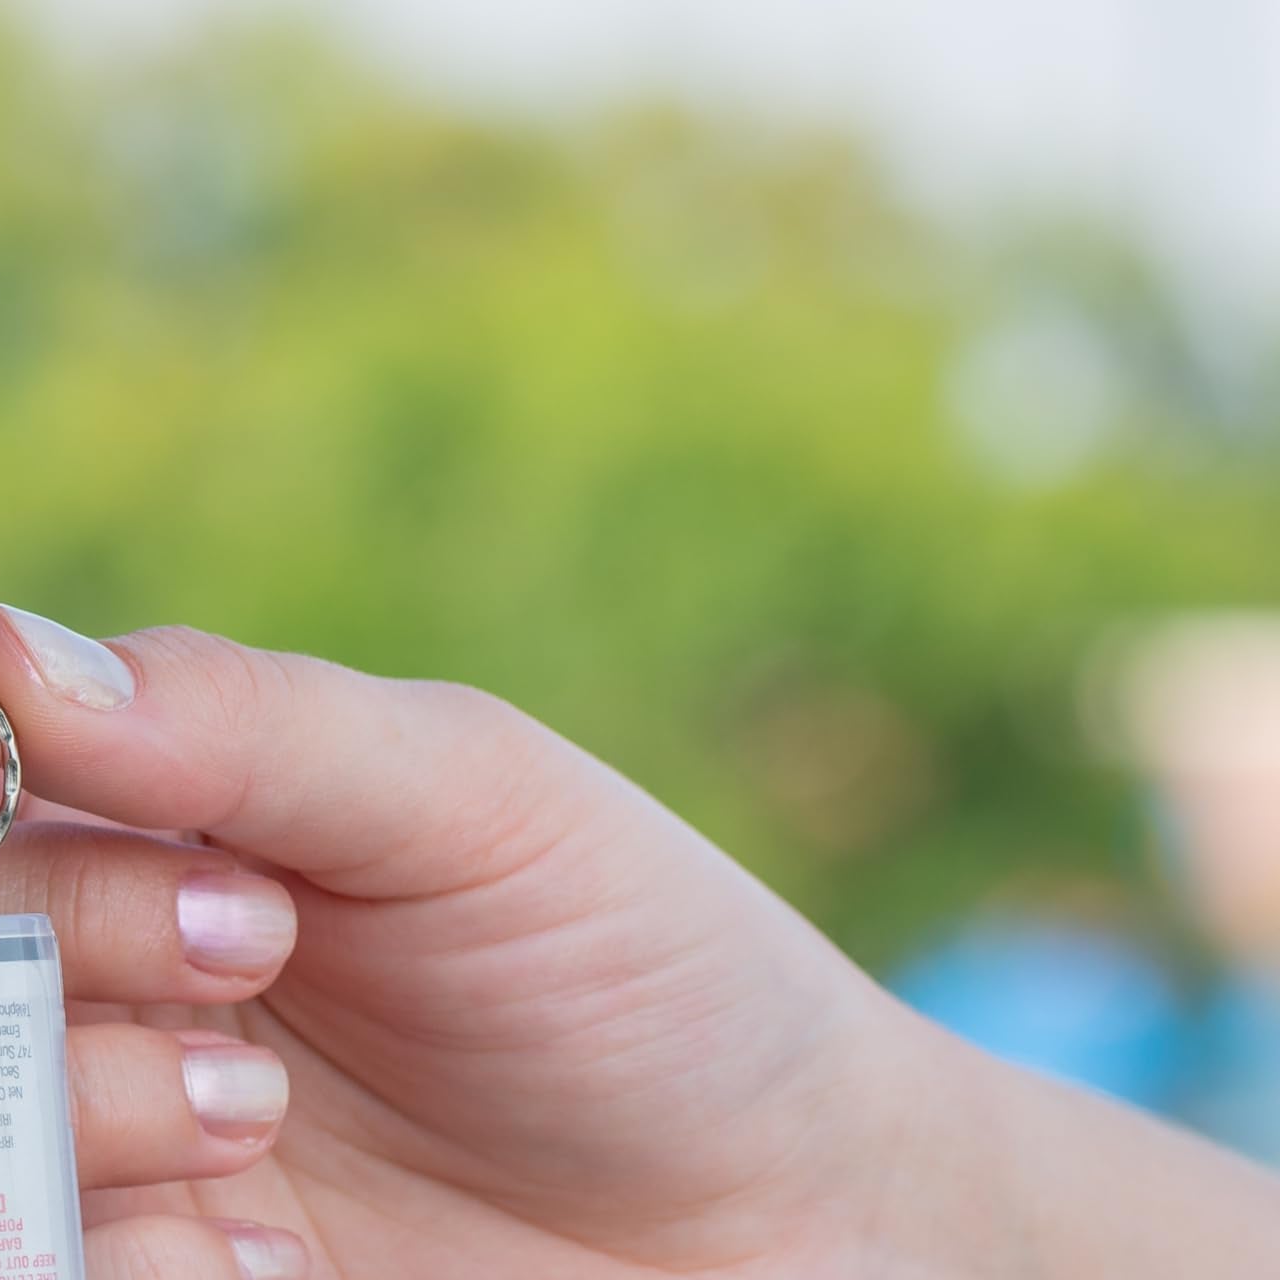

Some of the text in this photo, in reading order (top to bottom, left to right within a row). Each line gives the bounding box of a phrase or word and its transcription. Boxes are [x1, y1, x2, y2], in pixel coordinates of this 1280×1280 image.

[8, 1086, 22, 1099] Net
[6, 1256, 29, 1270] OUT
[33, 1254, 56, 1268] KEEP
